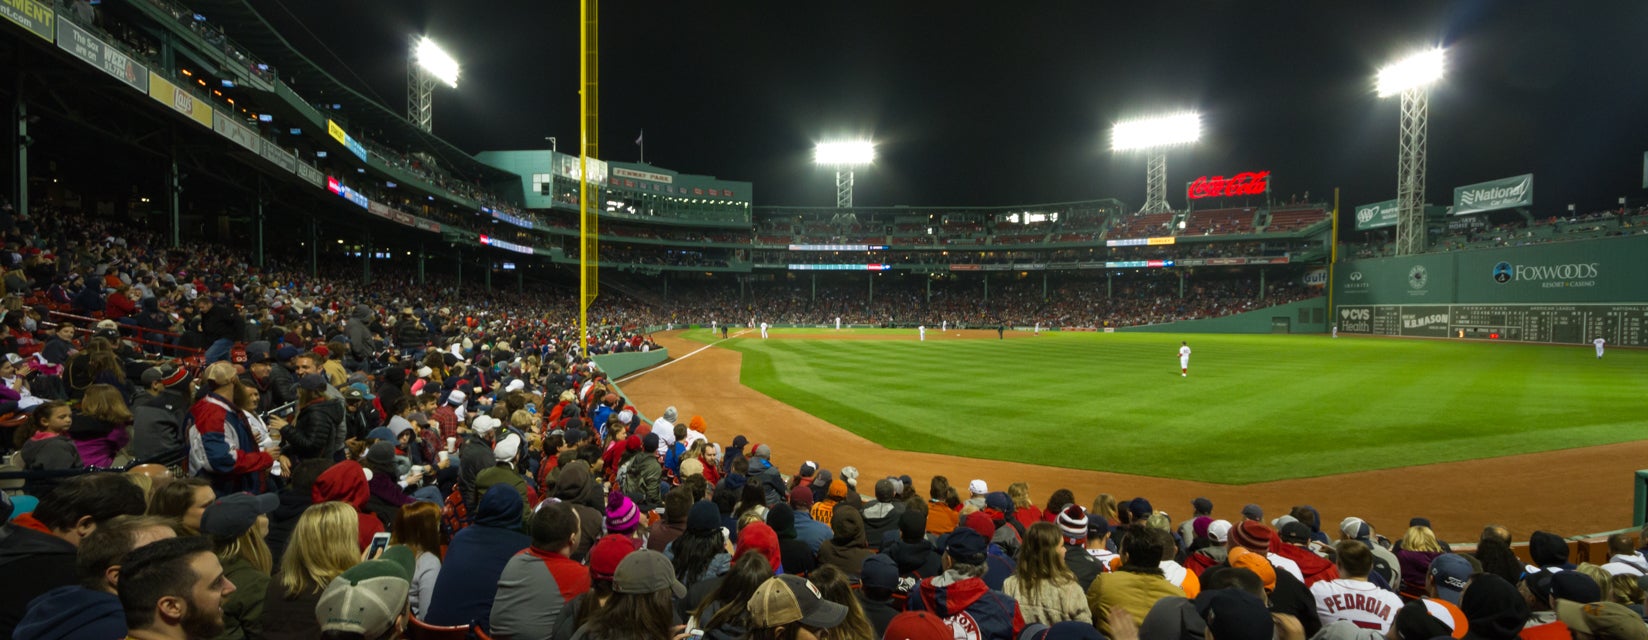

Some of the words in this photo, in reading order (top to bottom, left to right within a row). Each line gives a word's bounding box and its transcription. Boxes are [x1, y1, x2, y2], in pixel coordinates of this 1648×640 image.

[73, 29, 86, 45] The
[87, 38, 99, 53] Sox
[88, 50, 97, 61] on
[616, 169, 646, 179] FENWAY
[650, 174, 669, 182] PARK
[1188, 169, 1270, 199] Coca-Cola
[1474, 185, 1524, 202] National
[1350, 309, 1370, 320] CVS
[1342, 320, 1370, 332] Health
[1323, 593, 1391, 621] PEDROIA
